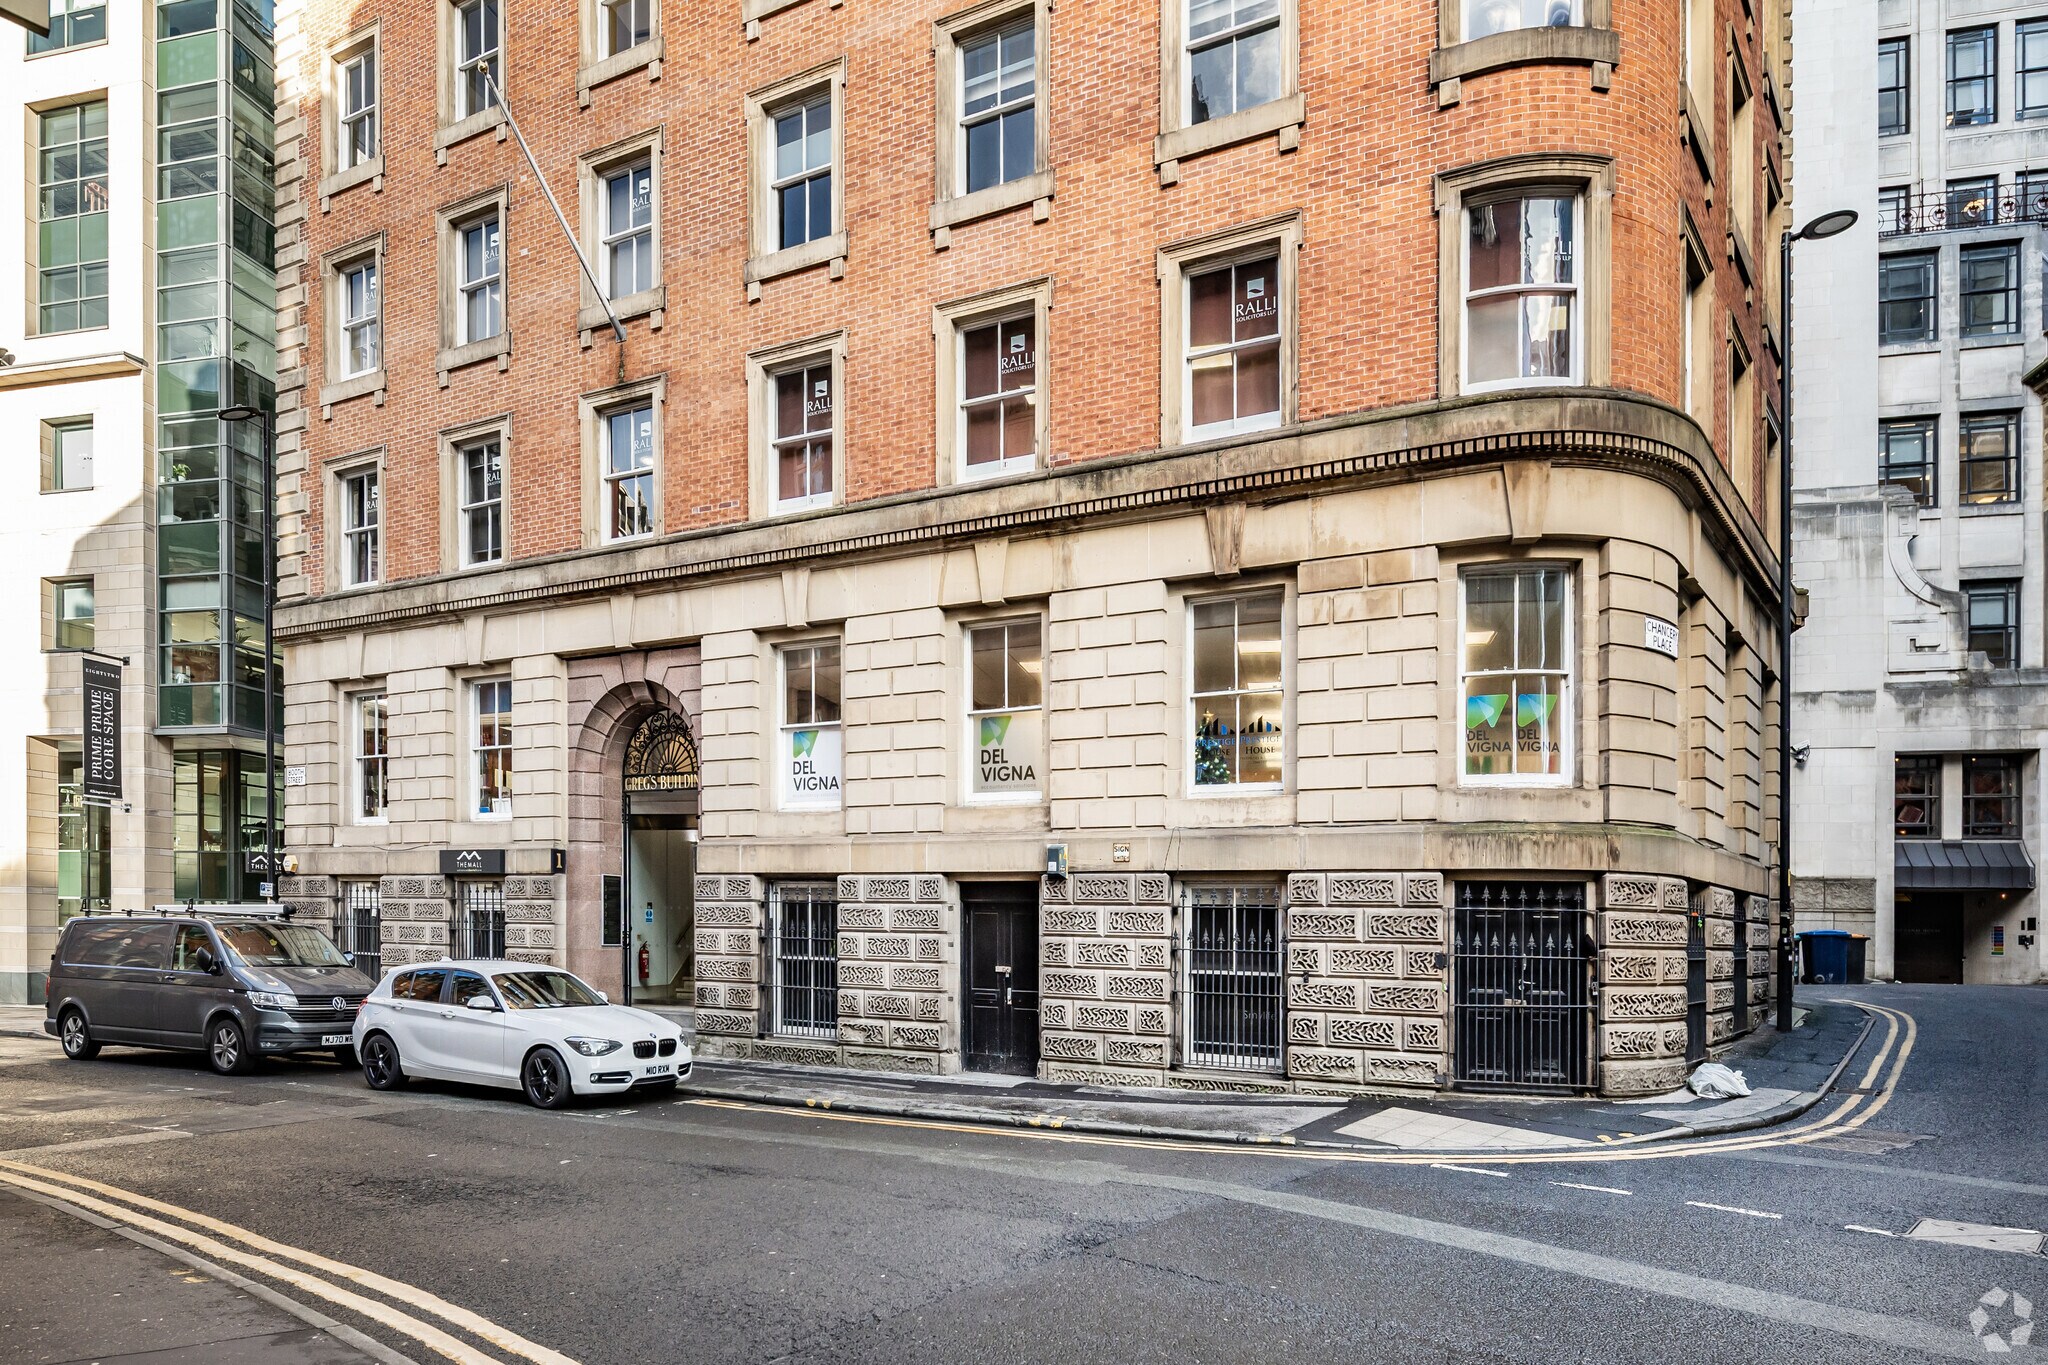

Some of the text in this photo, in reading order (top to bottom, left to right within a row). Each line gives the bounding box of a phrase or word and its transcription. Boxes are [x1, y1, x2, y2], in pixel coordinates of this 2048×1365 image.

[1236, 296, 1276, 317] RALLI
[1236, 310, 1267, 323] SOLICITORS
[1001, 351, 1035, 370] RALLI
[1653, 635, 1672, 652] PLACE
[91, 689, 102, 779] PRIME PRIME
[103, 691, 114, 780] CORE SPACE
[1467, 730, 1490, 741] DEL
[1517, 729, 1539, 740] DEL
[1245, 746, 1276, 755] HOUSE
[1467, 741, 1512, 753] VIGNA
[1517, 741, 1560, 753] VIGNA
[981, 748, 1008, 765] DEL
[288, 768, 304, 777] BOOTH
[793, 760, 816, 775] DEL
[981, 765, 1036, 782] VIGNA
[287, 776, 303, 784] STREET
[624, 774, 658, 791] GREG'S
[793, 776, 839, 791] VIGNA
[556, 852, 563, 869] 1
[324, 1035, 344, 1044] MJ70
